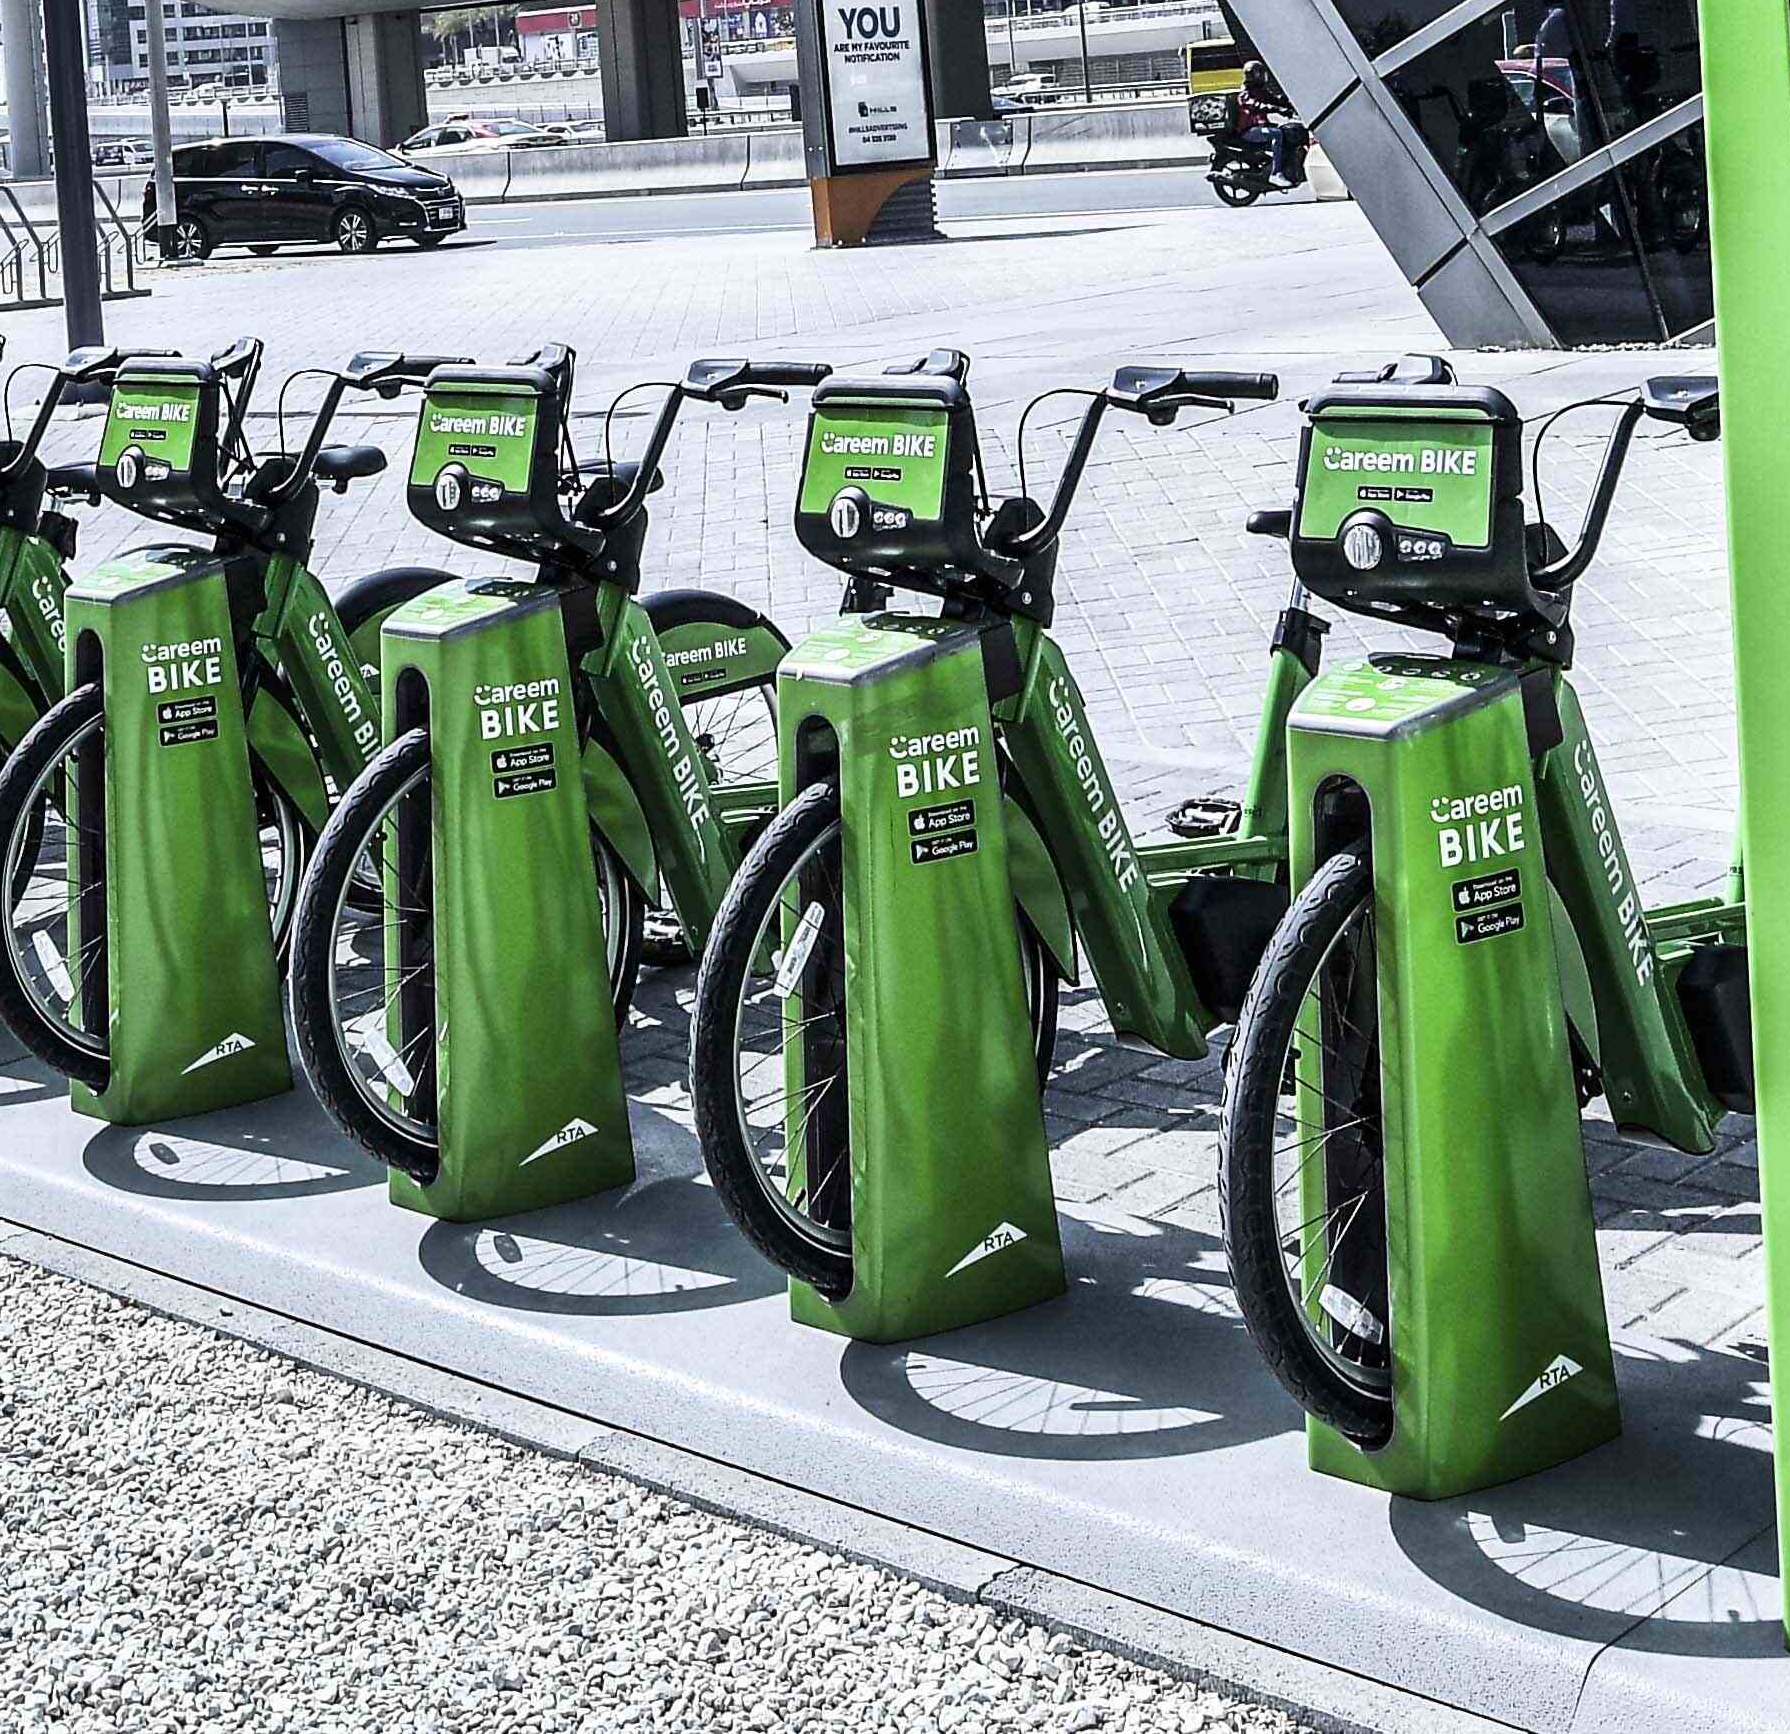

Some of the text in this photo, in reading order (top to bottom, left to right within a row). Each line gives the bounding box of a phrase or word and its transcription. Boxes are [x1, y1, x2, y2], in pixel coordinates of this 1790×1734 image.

[838, 7, 901, 39] YOU
[834, 40, 910, 52] ARE MY FAVOURITE
[845, 52, 900, 63] NOTIFICATION
[116, 402, 190, 421] Careem BIKE
[431, 413, 526, 437] Careem BIKE
[821, 432, 935, 457] Careem BIKE
[1323, 446, 1476, 475] Careem BIKE
[141, 637, 221, 663] Careem
[661, 638, 746, 667] areem BIKE
[148, 657, 222, 693] BIKE
[309, 612, 362, 722] Careem
[474, 678, 559, 706] Careem
[176, 708, 192, 718] App
[192, 705, 212, 714] Store
[480, 700, 560, 740] BIKE
[632, 635, 710, 830] Careem BIKE
[889, 726, 979, 759] Careem
[510, 753, 550, 767] App Store
[513, 777, 553, 792] Google Play
[896, 751, 980, 798] BIKE
[1049, 676, 1138, 893] Careem BIKE
[1430, 785, 1523, 823] Careem
[928, 812, 971, 829] App Store
[931, 840, 973, 856] Google Play
[1438, 812, 1525, 867] BIKE
[1574, 740, 1654, 986] Careem BIKE
[1474, 882, 1516, 902] App Store
[1477, 915, 1520, 934] Google Play
[216, 1040, 244, 1055] RTA
[557, 1126, 586, 1143] RTA
[984, 1231, 1014, 1251] RTA
[1540, 1365, 1570, 1388] RTA
